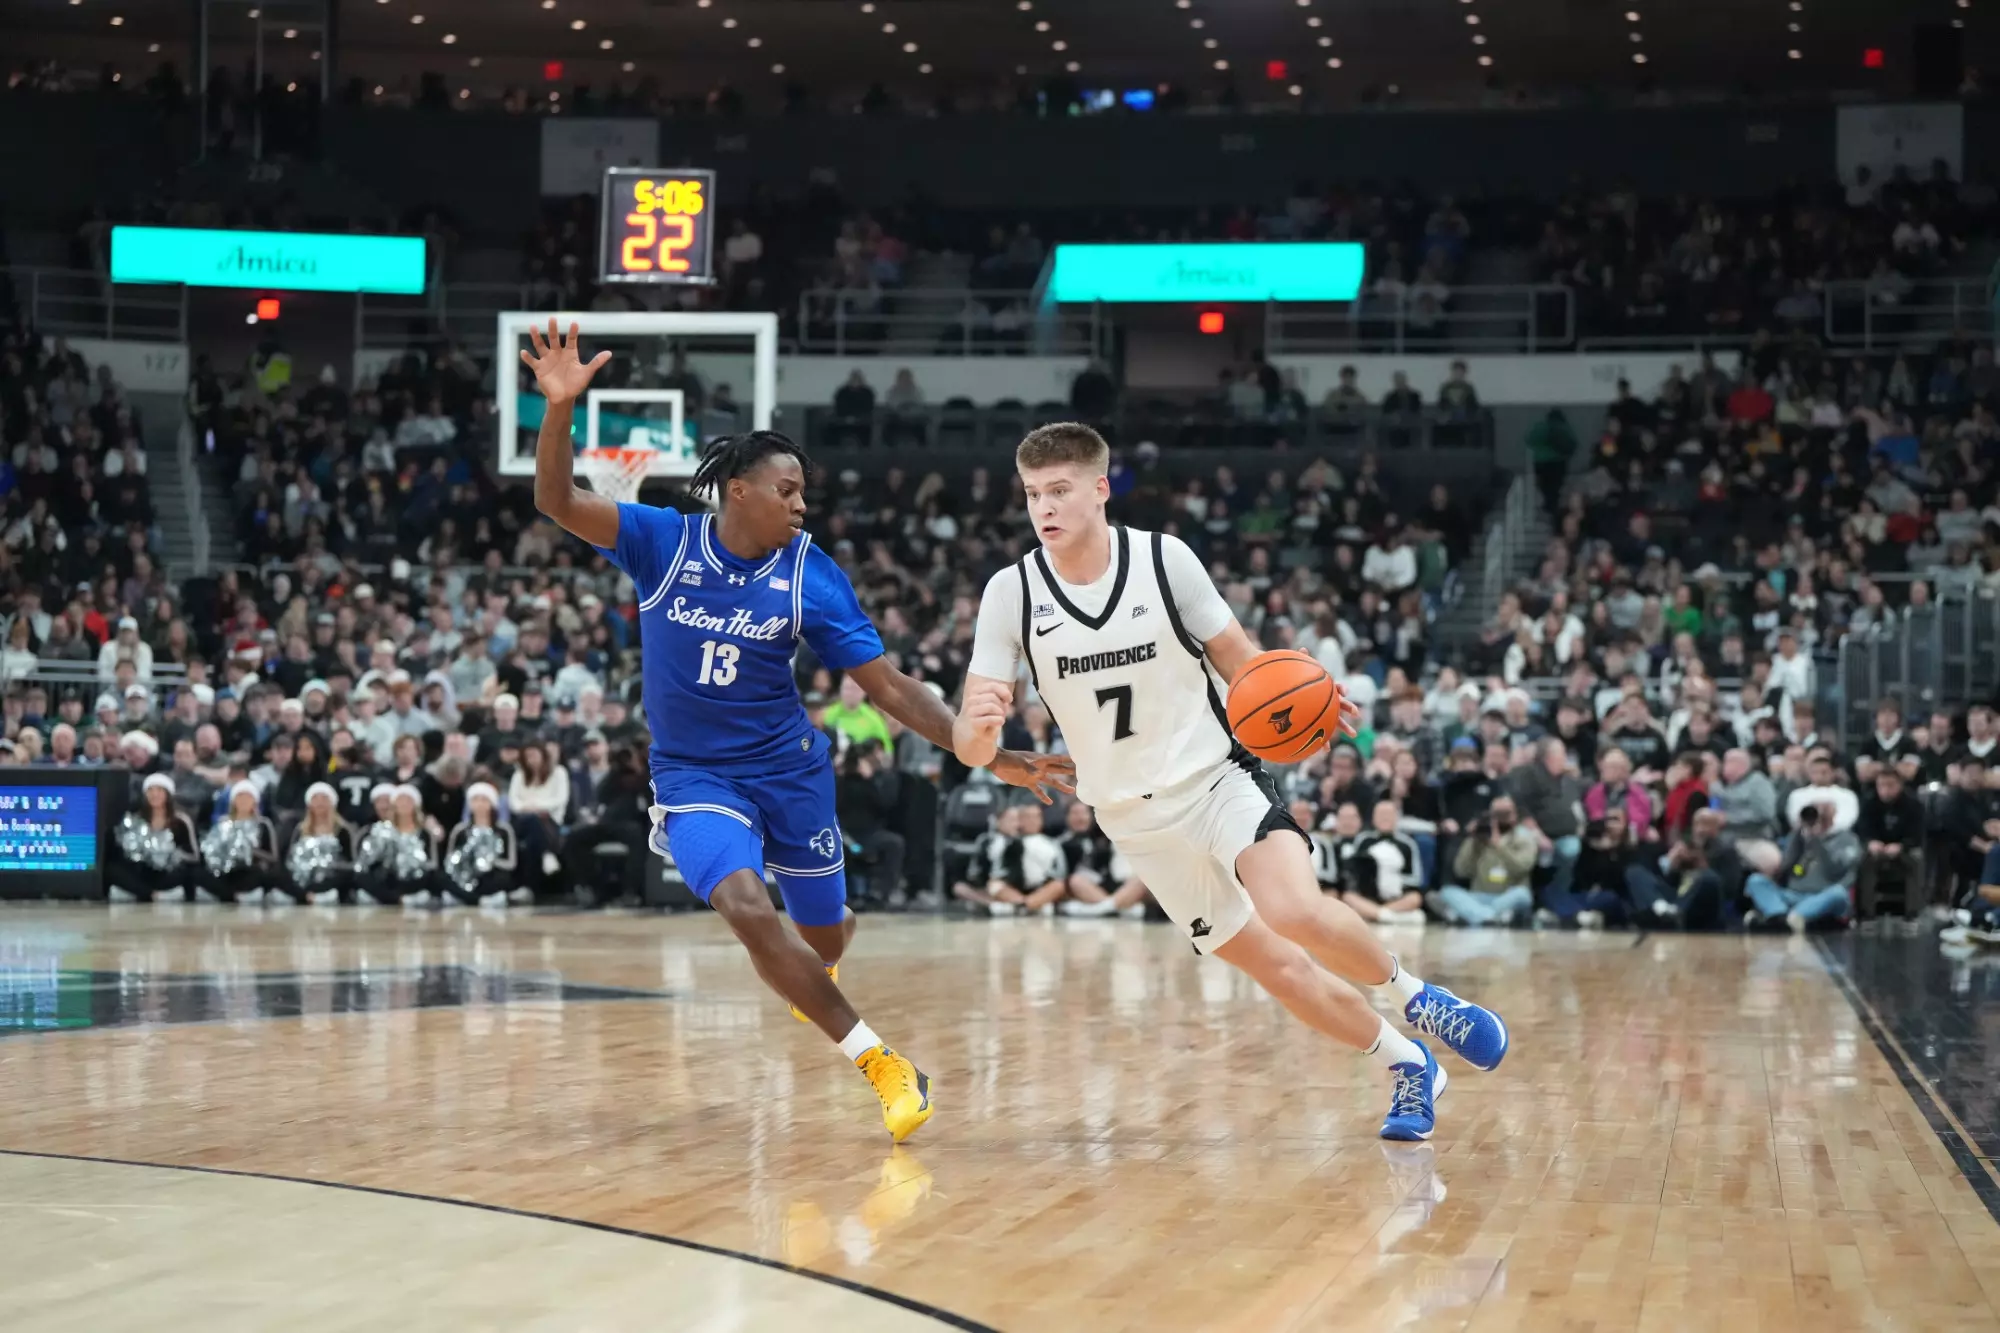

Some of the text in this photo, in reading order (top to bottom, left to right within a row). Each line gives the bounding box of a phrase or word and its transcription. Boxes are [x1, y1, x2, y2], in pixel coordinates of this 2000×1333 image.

[634, 180, 704, 215] 5:06
[216, 245, 317, 275] Amica
[622, 214, 695, 271] 22
[667, 596, 789, 640] Seton Hall
[696, 640, 740, 686] 13
[1056, 641, 1157, 680] PROVIDENCE
[1093, 682, 1139, 744] 7
